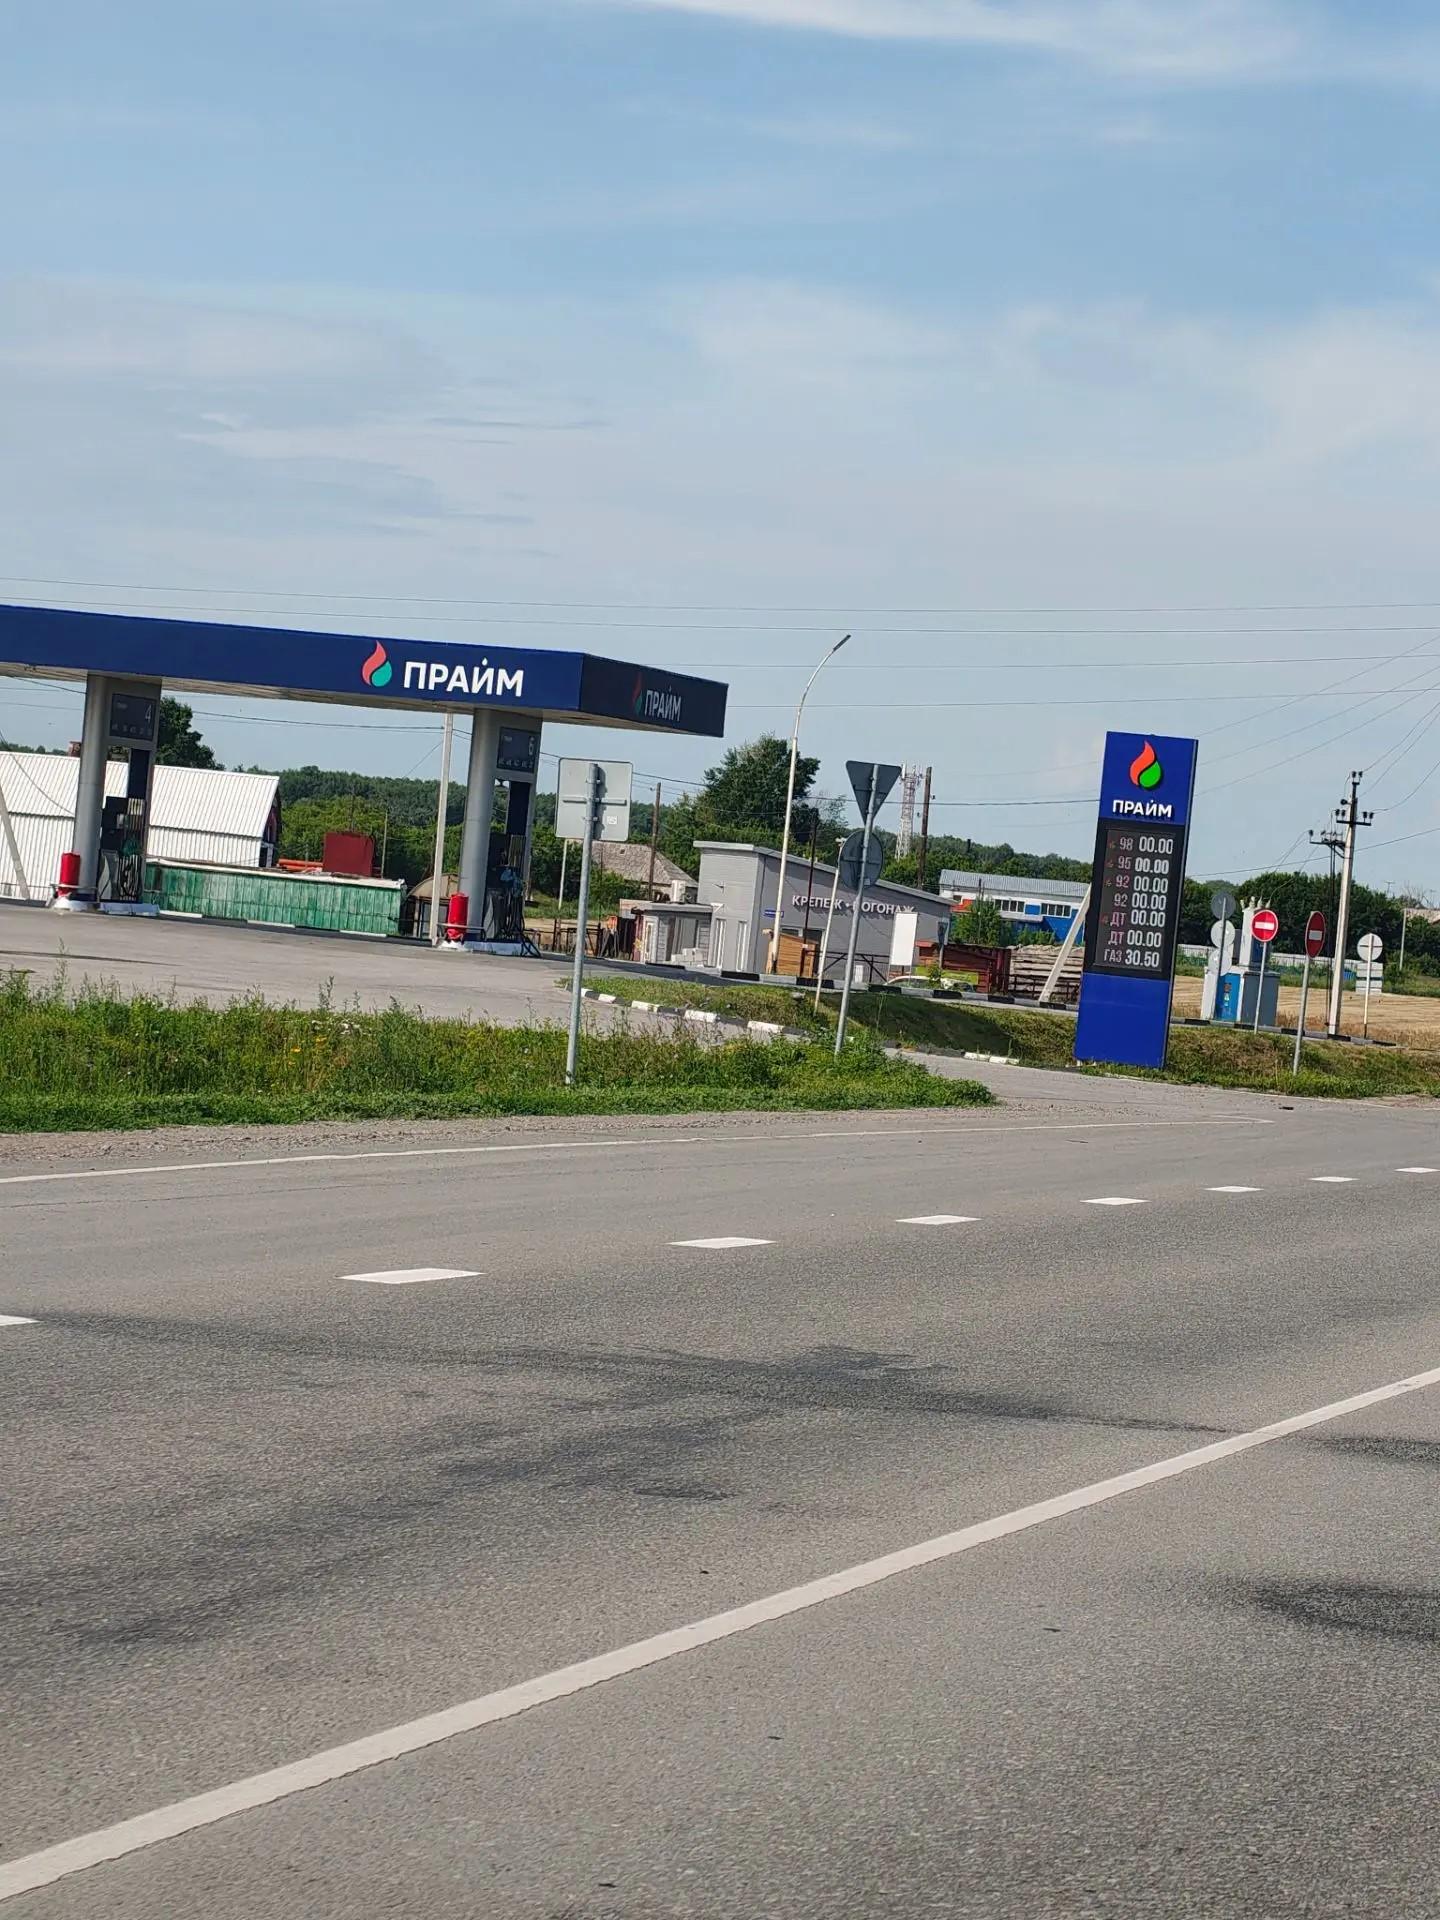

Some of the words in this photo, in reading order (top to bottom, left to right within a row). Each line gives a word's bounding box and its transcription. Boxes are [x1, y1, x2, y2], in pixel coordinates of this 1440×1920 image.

[403, 657, 524, 697] ПРАЙМ
[644, 685, 682, 722] ПРАЙМ
[1112, 799, 1172, 818] ПРАЙМ
[1119, 837, 1134, 851] 98
[1139, 836, 1174, 854] 00.00
[1118, 856, 1132, 870] 95
[1134, 857, 1170, 874] 00.00
[1115, 874, 1130, 888] 92
[1133, 876, 1169, 894] 00.00
[1114, 893, 1128, 907] 92
[1131, 892, 1167, 910] 00.00
[1110, 911, 1127, 927] ДТ
[1131, 909, 1166, 927] 00.00
[1108, 930, 1125, 946] ДТ
[1127, 929, 1162, 948] 00.00
[1104, 949, 1122, 963] ГАЗ
[1125, 949, 1160, 968] 30.50
